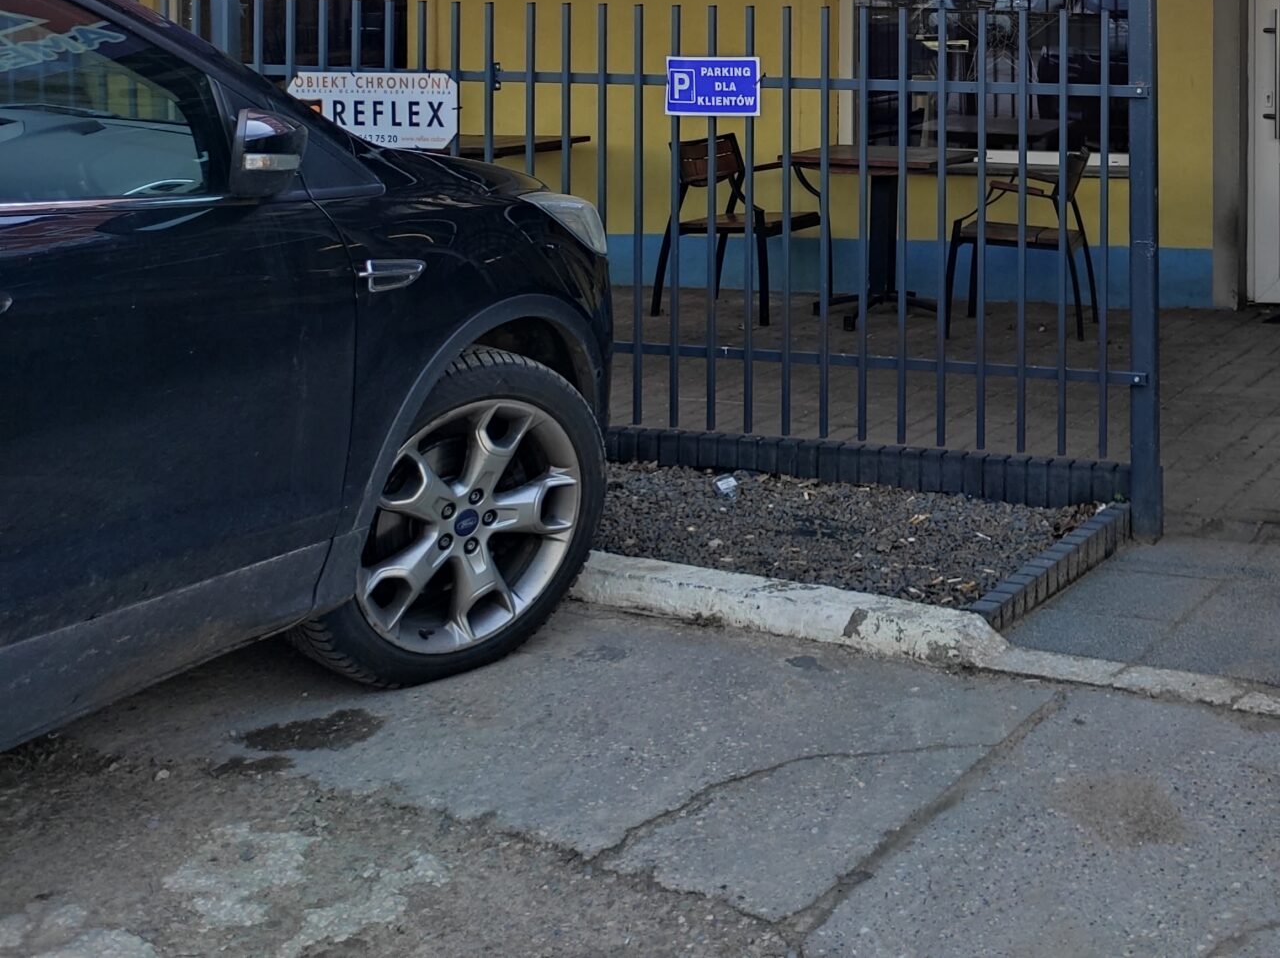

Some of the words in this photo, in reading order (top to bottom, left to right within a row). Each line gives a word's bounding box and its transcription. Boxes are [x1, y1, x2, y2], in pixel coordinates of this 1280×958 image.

[700, 66, 751, 77] PARKING
[294, 76, 347, 89] OBIEKT
[355, 76, 451, 90] CHRONIONY
[673, 72, 690, 99] P
[714, 81, 737, 92] DLA
[697, 94, 755, 106] KLIENTÓW
[332, 99, 445, 128] REFLEX
[375, 134, 386, 143] 75
[387, 135, 398, 143] 20
